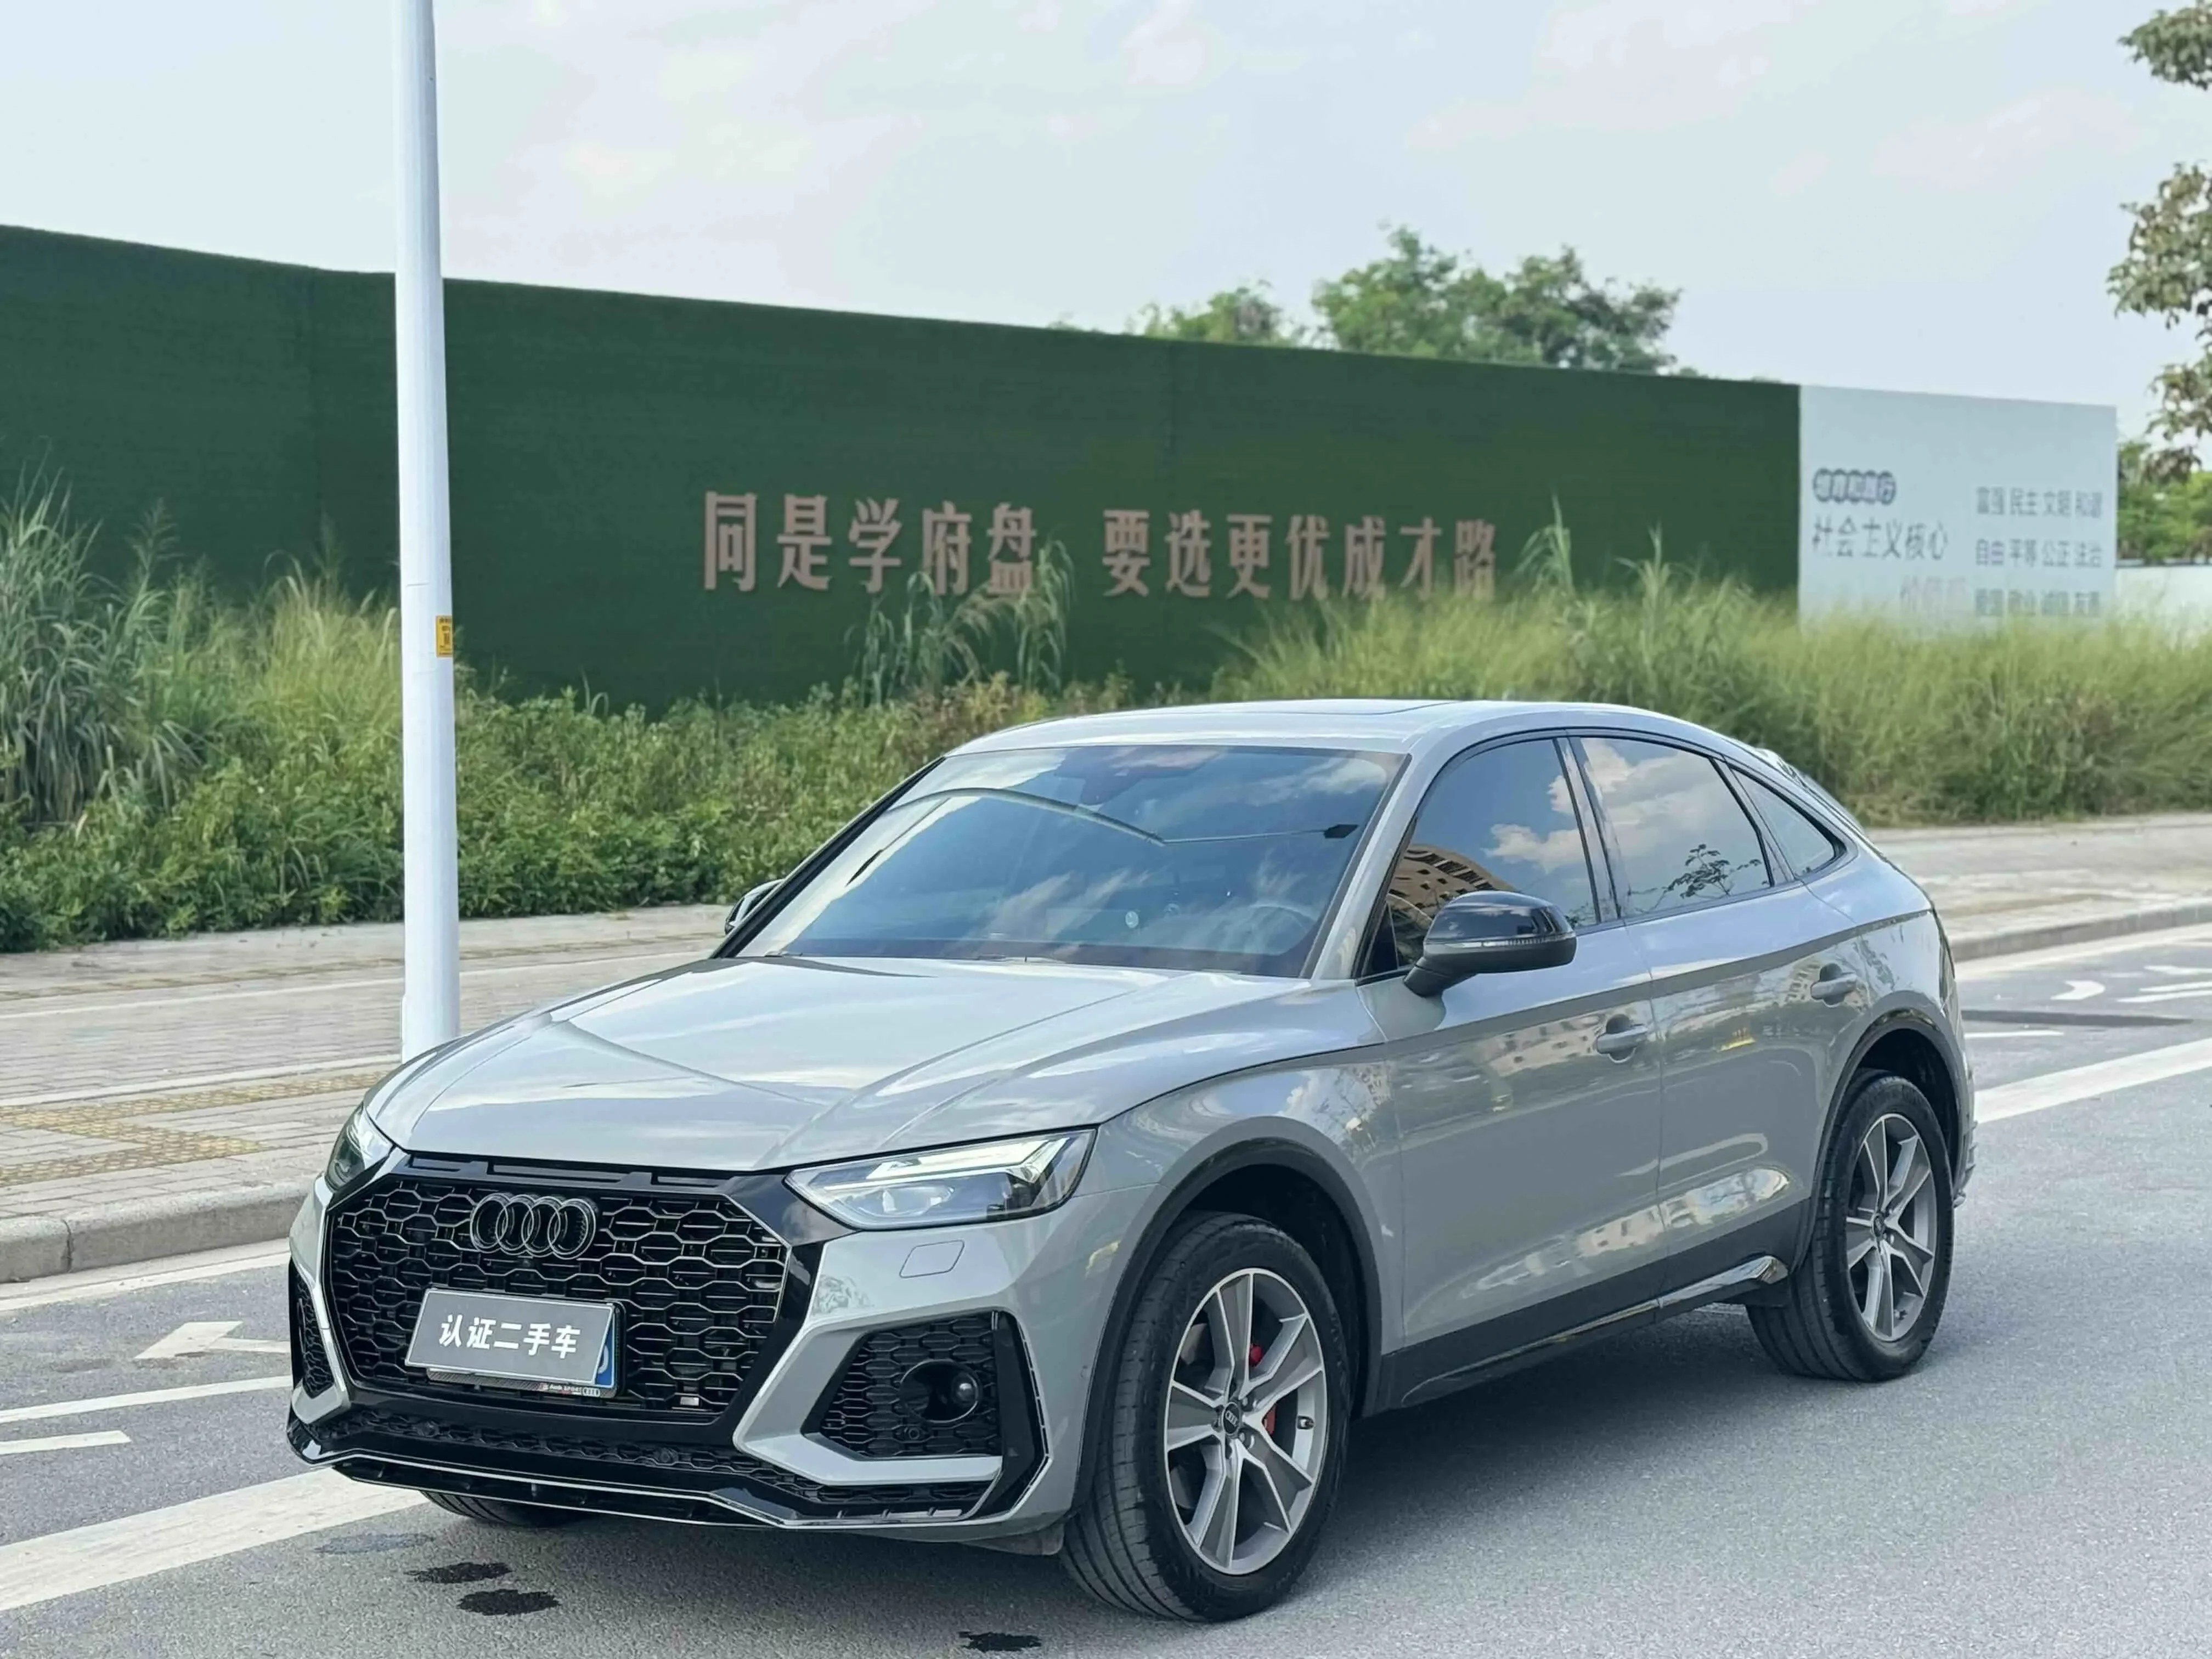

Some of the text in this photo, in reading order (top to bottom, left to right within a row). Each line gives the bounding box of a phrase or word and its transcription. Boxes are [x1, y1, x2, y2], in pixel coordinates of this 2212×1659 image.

[704, 491, 1496, 601] 同是学府盘 要选更优成才路
[439, 1314, 580, 1359] 认证二手车
